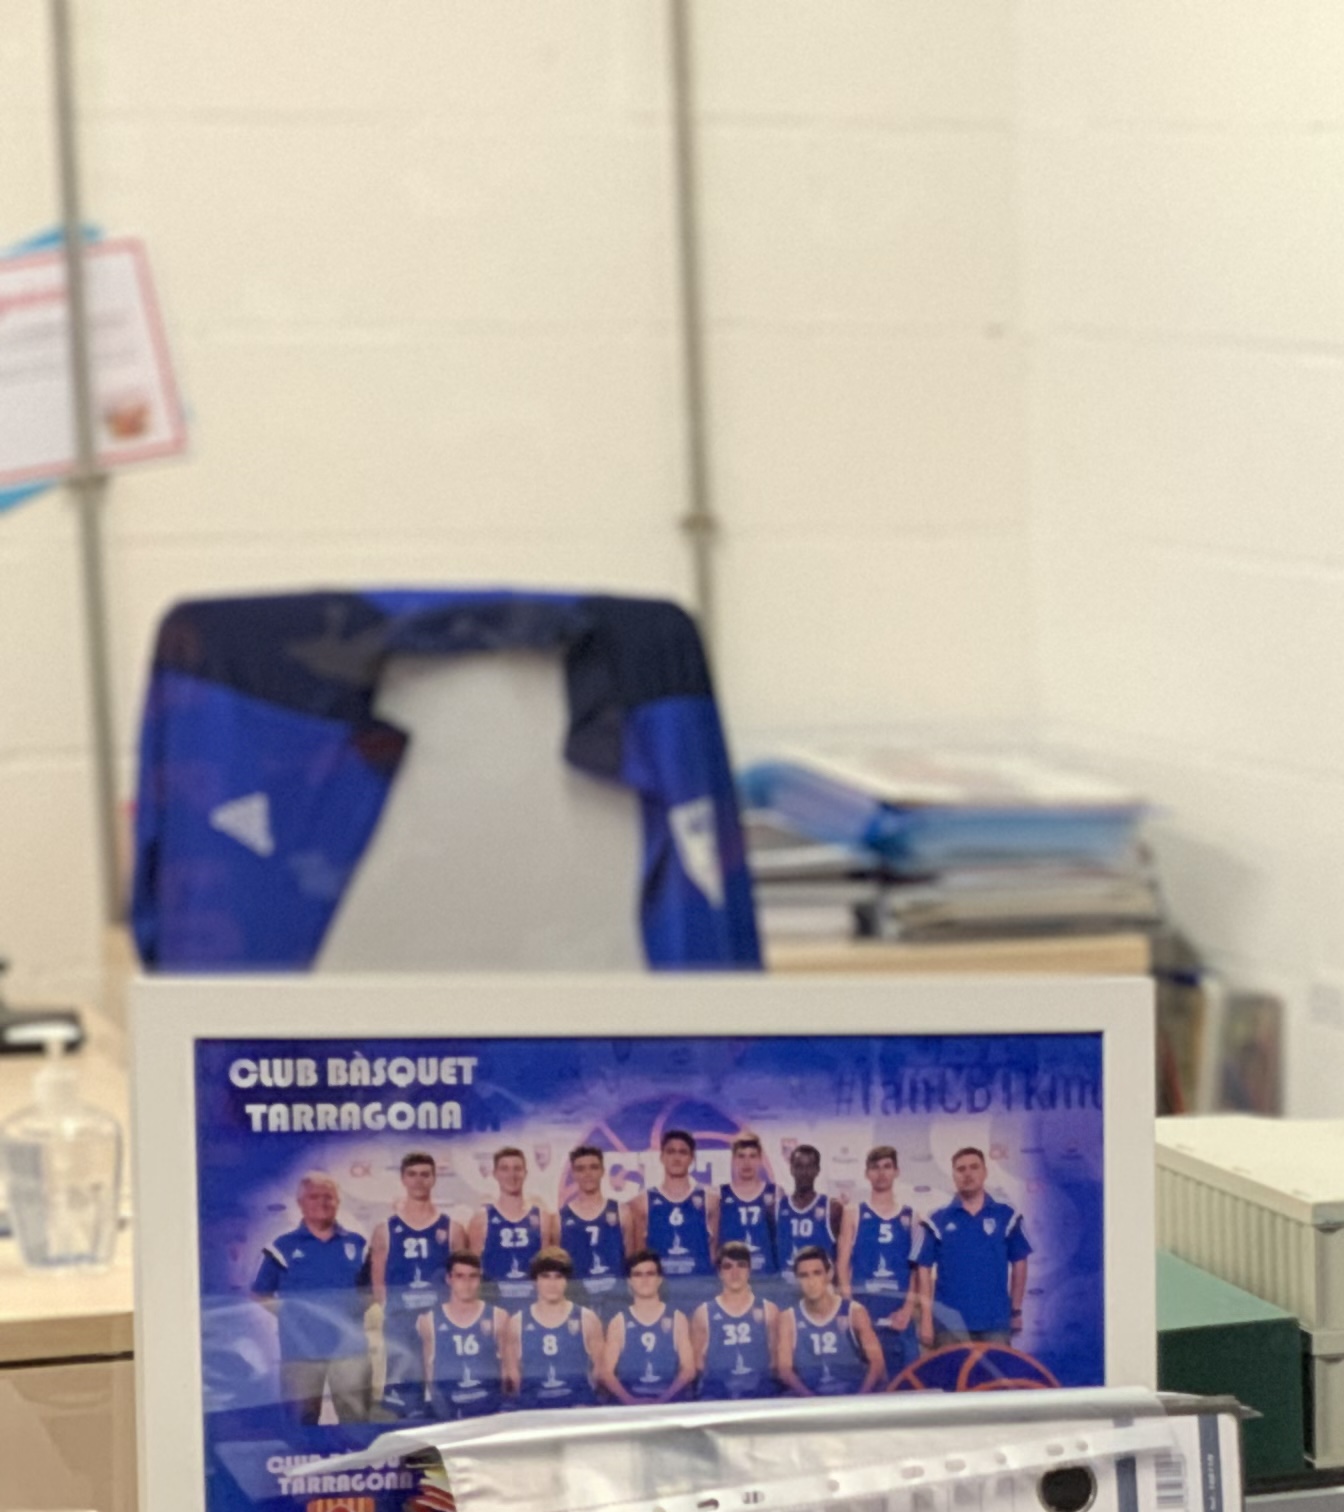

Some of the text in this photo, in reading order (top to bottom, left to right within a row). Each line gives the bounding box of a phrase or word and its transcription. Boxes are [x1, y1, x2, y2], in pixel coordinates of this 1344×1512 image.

[228, 1050, 478, 1089] CLUB BÀSQUET
[245, 1101, 463, 1133] TARRAGONA
[669, 1206, 684, 1227] 6
[739, 1206, 760, 1226] 17
[500, 1227, 529, 1248] 23
[585, 1225, 600, 1247] 7
[790, 1218, 813, 1238] 10
[878, 1223, 893, 1244] 5
[403, 1237, 429, 1259] 21
[453, 1334, 480, 1356] 16
[542, 1335, 558, 1357] 8
[641, 1331, 655, 1352] 9
[723, 1324, 751, 1346] 32
[810, 1332, 838, 1355] 12
